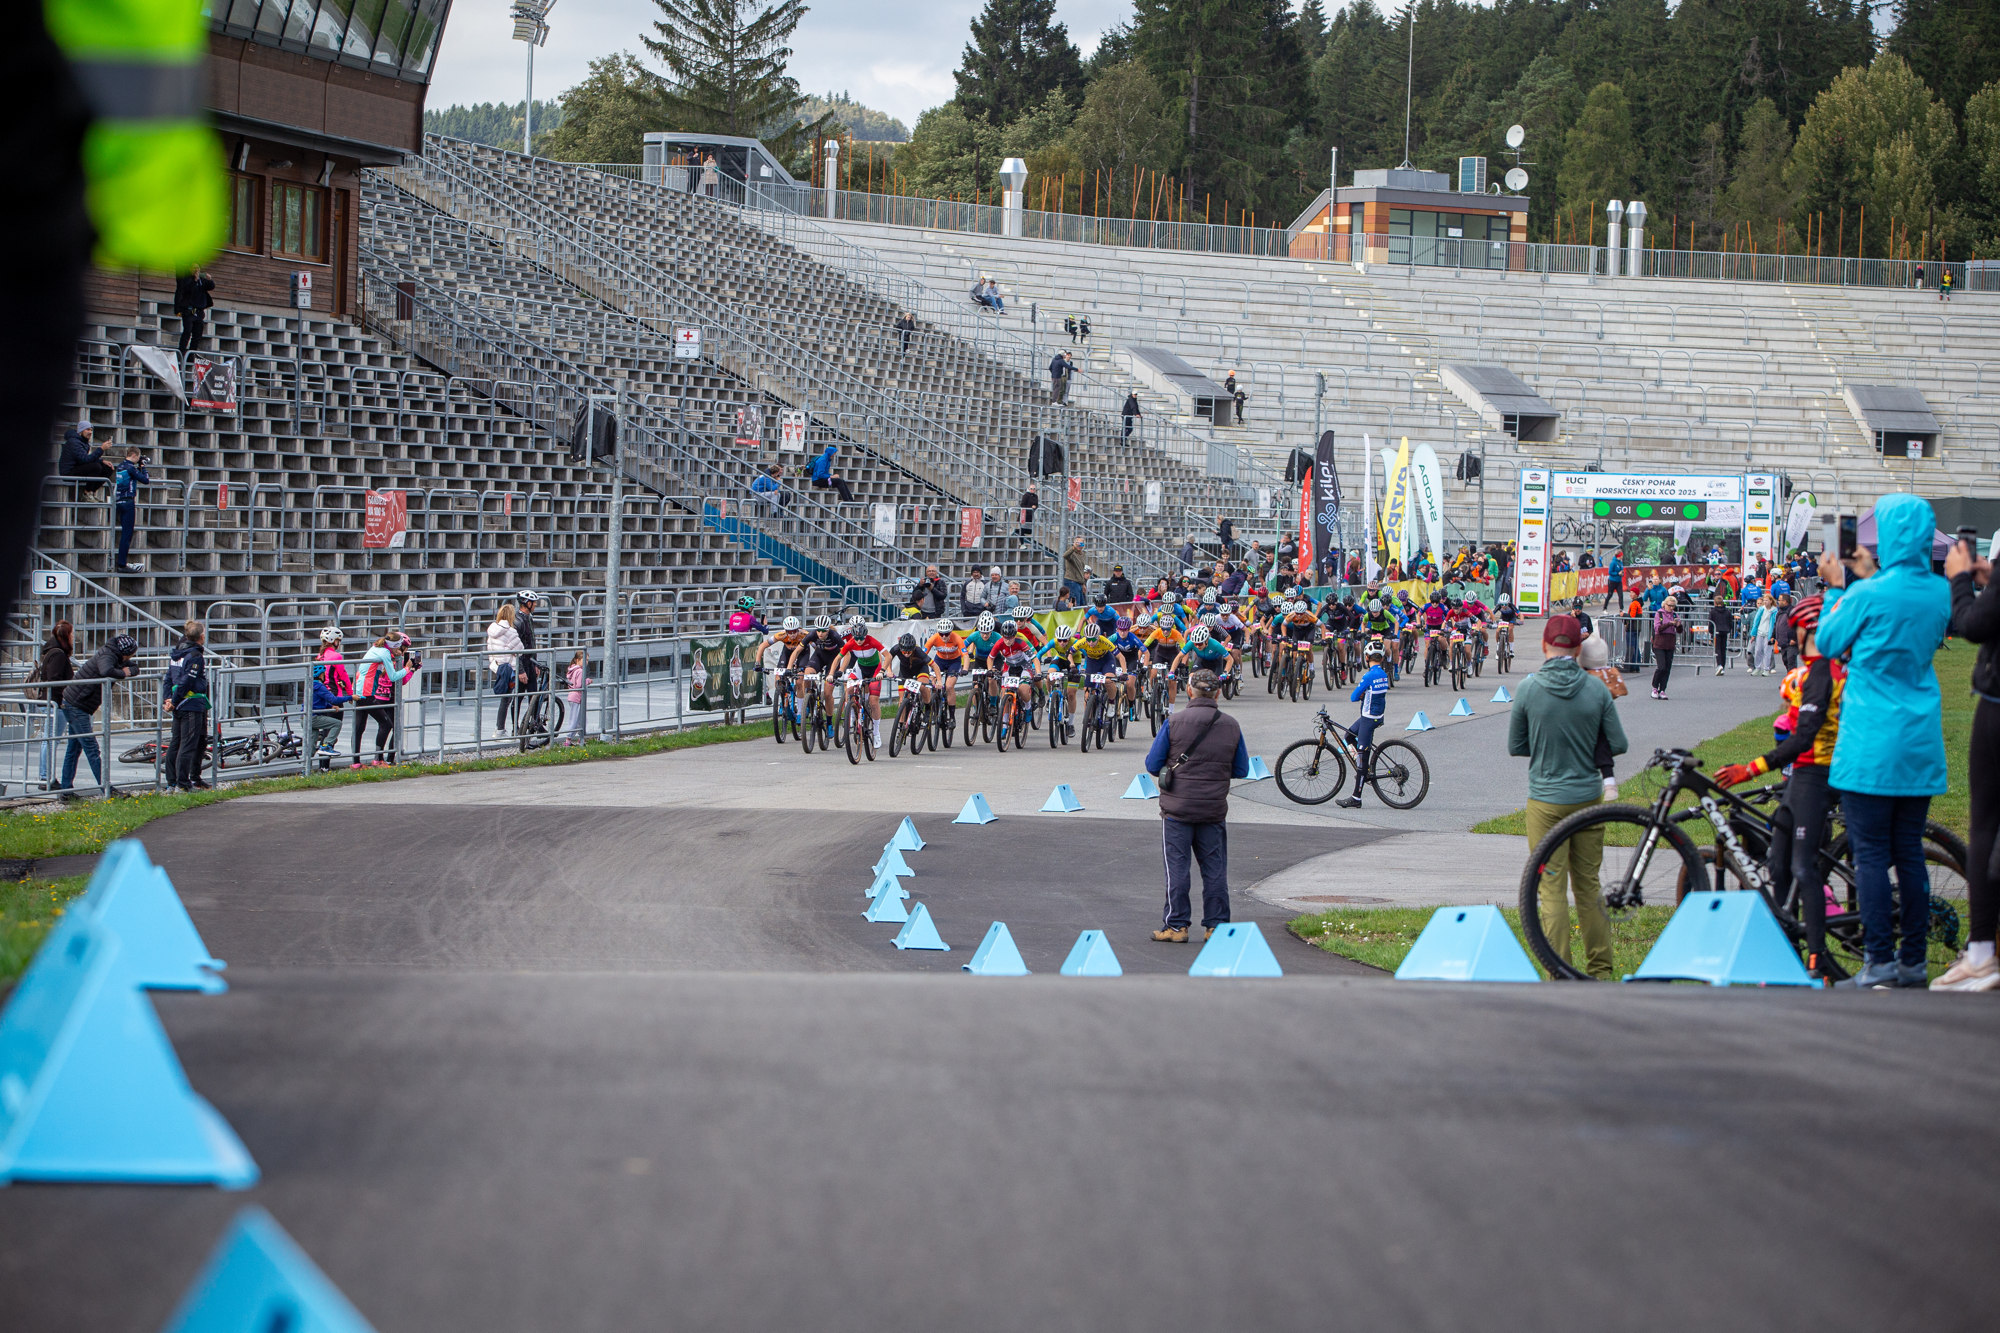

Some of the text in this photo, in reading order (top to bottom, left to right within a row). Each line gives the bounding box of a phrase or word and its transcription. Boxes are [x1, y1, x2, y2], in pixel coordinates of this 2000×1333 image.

[1596, 486, 1638, 495] HORSKÝCH
[1615, 506, 1676, 515] GO! GO!
[46, 576, 57, 589] B
[906, 680, 919, 689] 752
